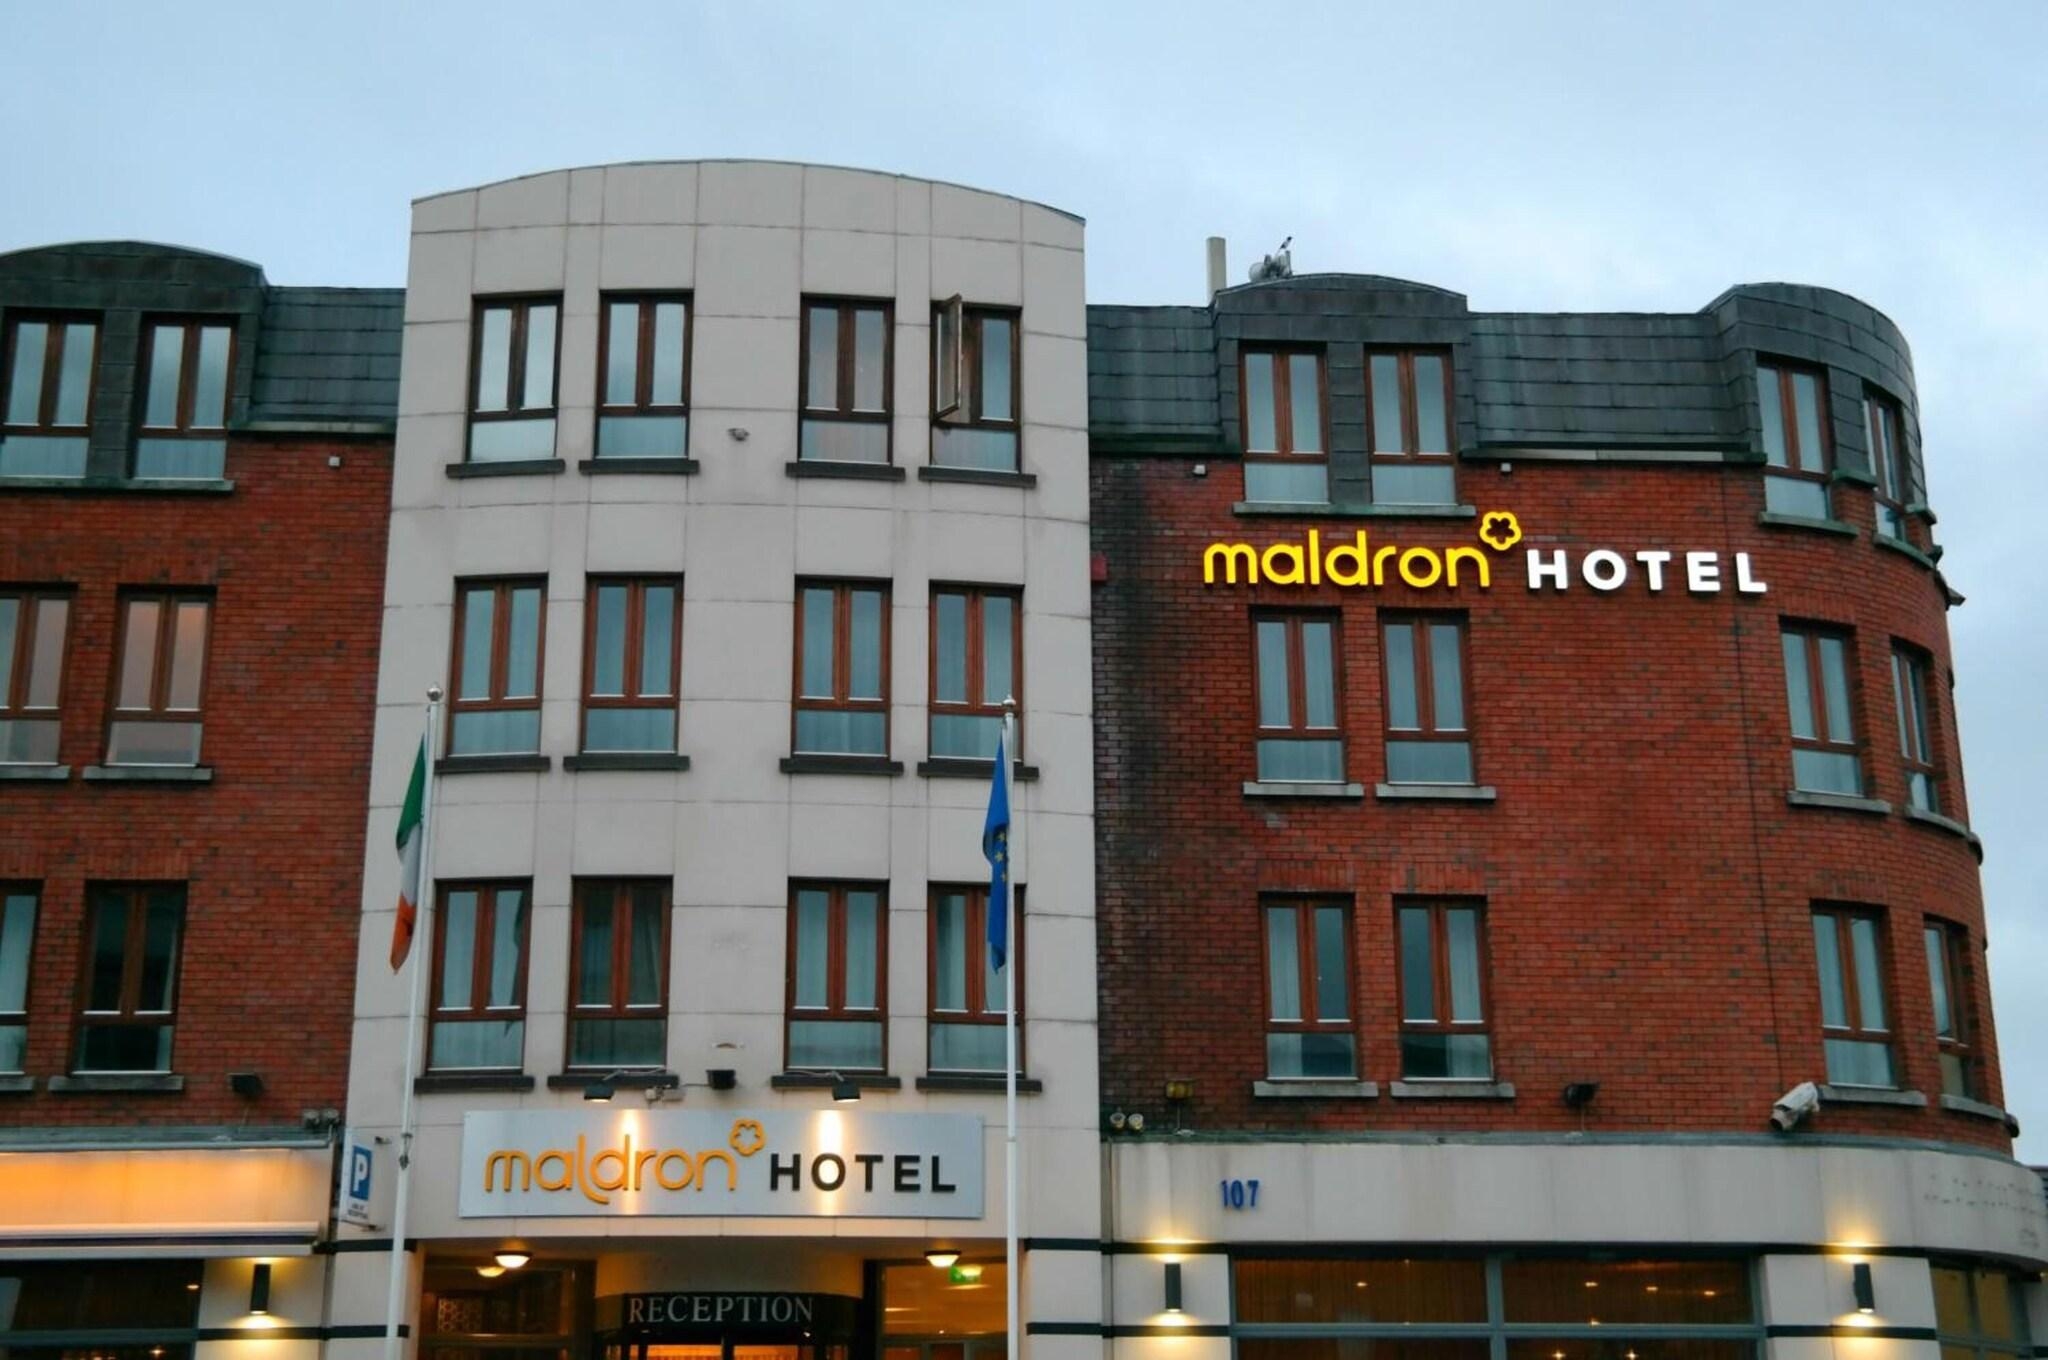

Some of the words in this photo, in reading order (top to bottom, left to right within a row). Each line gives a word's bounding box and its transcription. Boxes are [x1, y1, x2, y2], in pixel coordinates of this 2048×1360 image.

[1203, 529, 1490, 588] maldron
[1527, 549, 1767, 593] HOTEL
[353, 1154, 368, 1192] P
[484, 1134, 738, 1205] maldron
[770, 1153, 957, 1194] HOTEL
[1221, 1180, 1259, 1209] 107
[629, 1296, 813, 1324] RECEPTION
